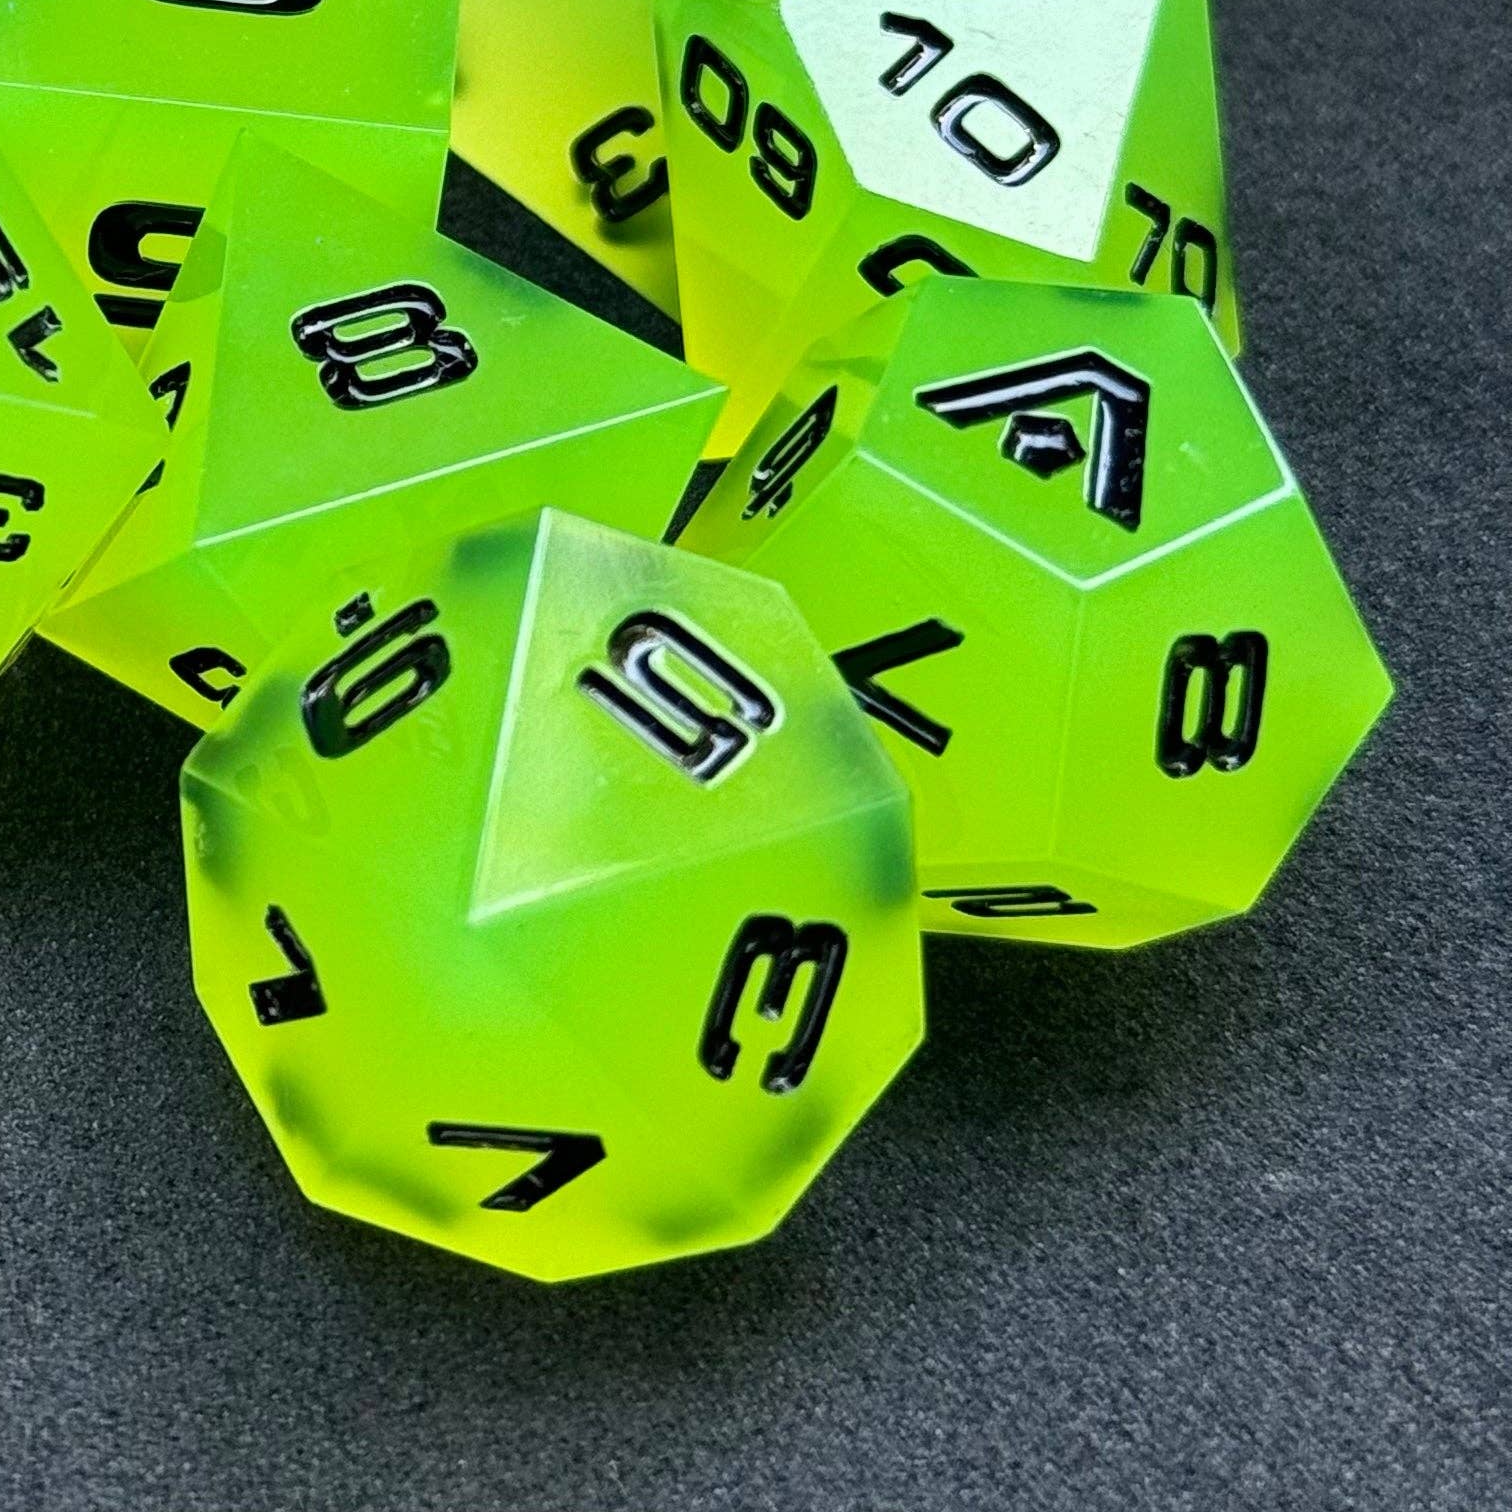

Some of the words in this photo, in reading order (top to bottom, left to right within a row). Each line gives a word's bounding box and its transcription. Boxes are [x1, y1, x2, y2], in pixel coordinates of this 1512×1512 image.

[569, 105, 669, 223] 3
[878, 10, 1061, 188] 10
[291, 281, 479, 411] 8
[576, 608, 778, 788] 5
[1155, 631, 1269, 779] 8
[697, 914, 849, 1095] 3
